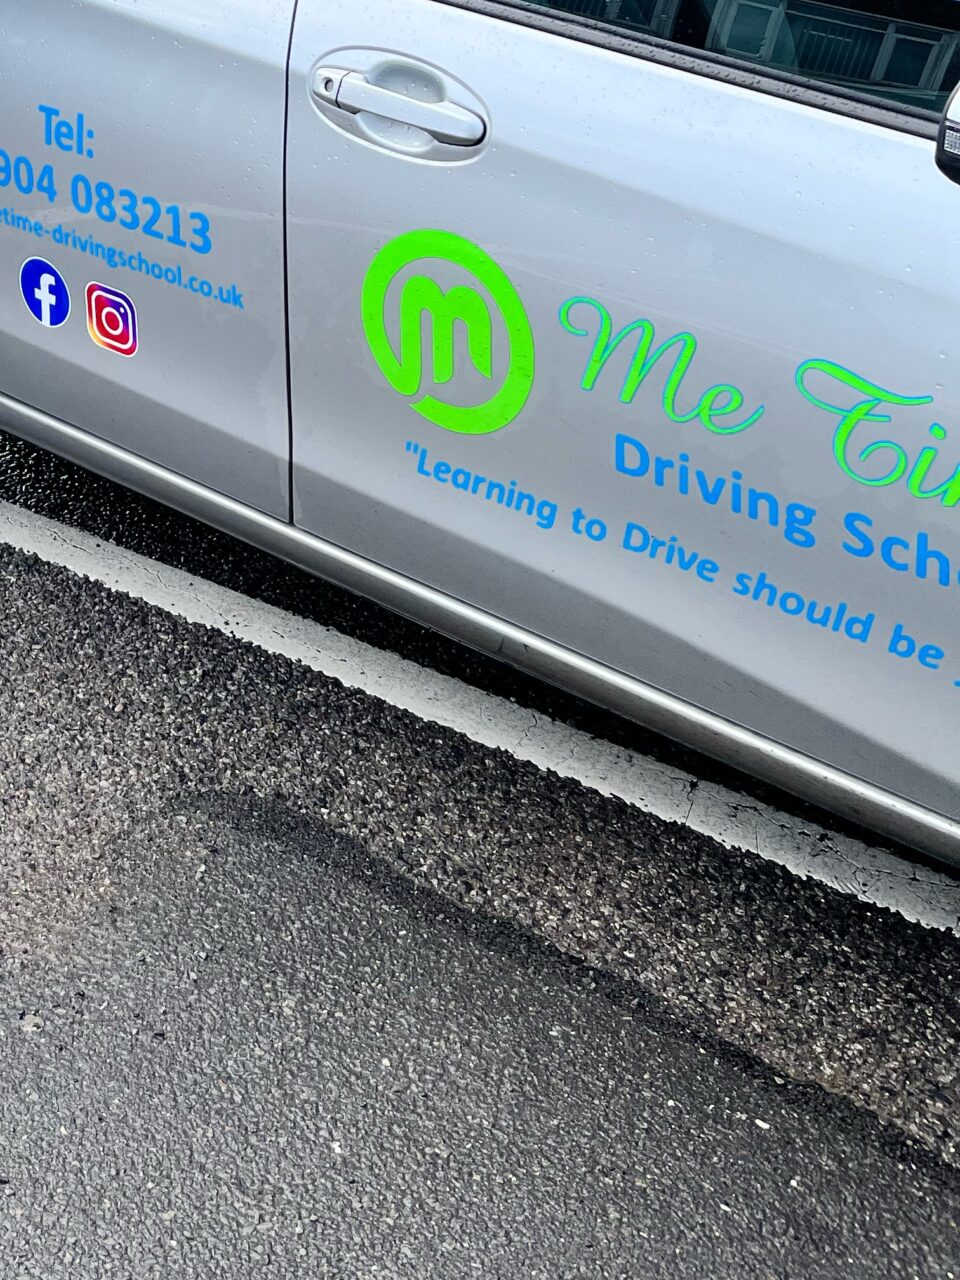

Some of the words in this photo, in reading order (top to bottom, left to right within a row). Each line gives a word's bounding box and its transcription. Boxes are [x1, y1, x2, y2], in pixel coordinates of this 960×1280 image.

[38, 104, 95, 159] Tel:
[71, 174, 212, 255] 083213
[558, 296, 765, 435] Me
[795, 358, 960, 508] Ti
[405, 440, 558, 530] "Learning
[571, 509, 608, 543] to
[622, 522, 720, 583] Drive
[731, 569, 875, 644] should
[887, 623, 945, 671] be
[614, 433, 818, 549] Driving
[841, 511, 960, 587] Sch
